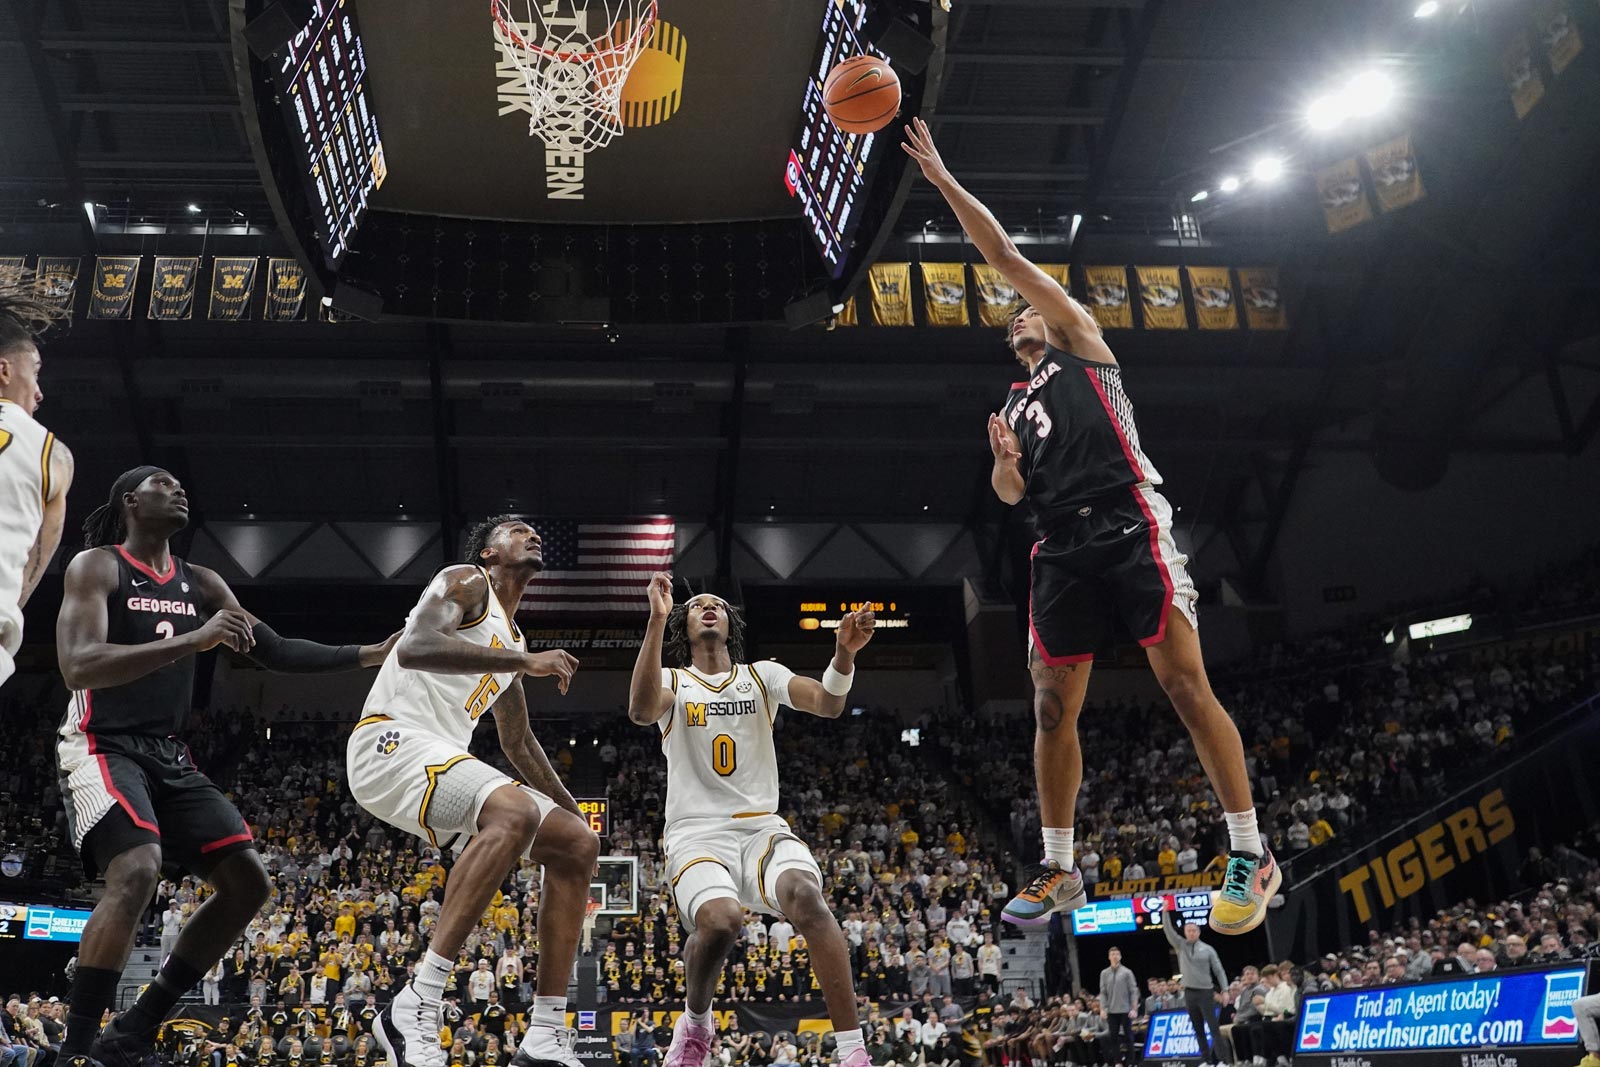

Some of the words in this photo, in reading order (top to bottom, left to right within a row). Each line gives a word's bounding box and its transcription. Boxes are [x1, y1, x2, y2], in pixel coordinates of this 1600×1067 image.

[494, 20, 539, 117] BANK
[544, 40, 588, 200] SOUTHERN
[103, 274, 126, 288] M
[163, 274, 186, 288] M
[222, 274, 244, 288] M
[1026, 400, 1052, 438] 3
[127, 596, 196, 617] GEORGIA
[800, 602, 826, 612] AUBURN
[526, 629, 590, 639] ROBERTS
[820, 620, 842, 628] GREA
[530, 640, 587, 648] STUDENT
[592, 640, 642, 648] SECTION
[464, 673, 500, 722] 15
[686, 700, 756, 726] MISSOURI
[712, 734, 736, 776] 0
[1339, 788, 1516, 923] TIGERS
[1094, 878, 1159, 896] ELLIOTT
[1164, 871, 1224, 888] FAMILY
[1354, 993, 1383, 1018] Find
[1384, 998, 1401, 1017] an
[1404, 989, 1448, 1020] Agent
[1450, 982, 1500, 1015] today!
[1331, 1019, 1523, 1050] ShelterInsurance.com
[1470, 1055, 1497, 1067] Health
[1498, 1054, 1518, 1067] Care
